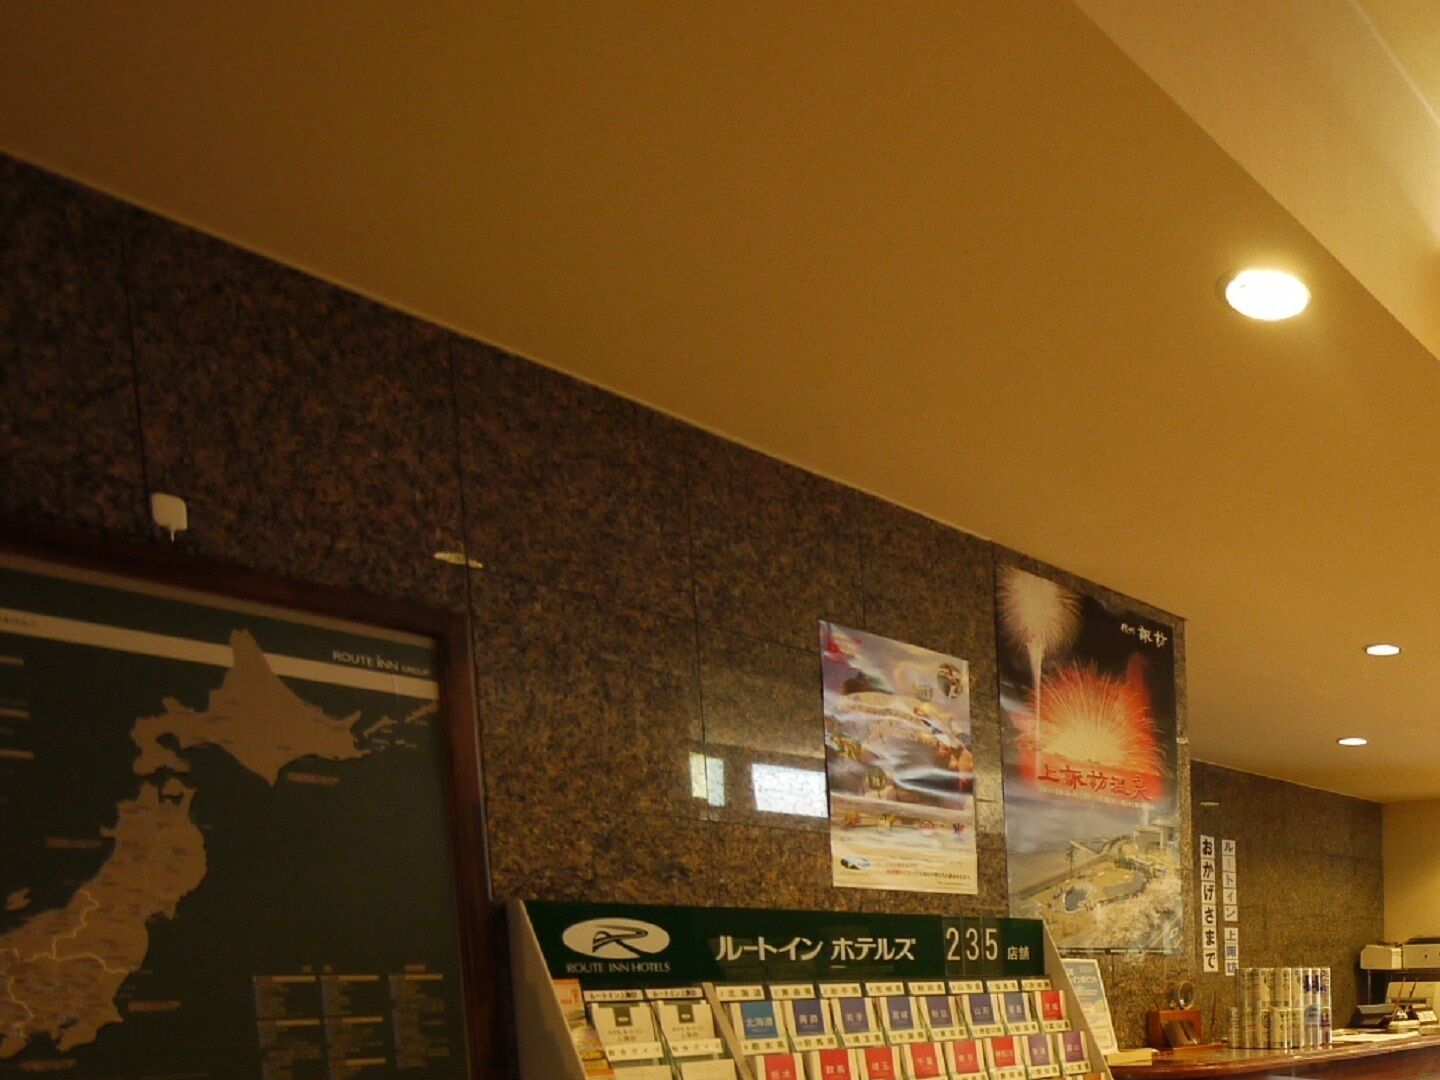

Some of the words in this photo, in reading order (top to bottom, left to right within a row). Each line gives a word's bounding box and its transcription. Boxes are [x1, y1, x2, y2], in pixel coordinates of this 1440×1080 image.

[332, 649, 374, 668] ROUTE
[1202, 838, 1216, 969] おかげさまで
[715, 935, 824, 961] ルートイン
[830, 937, 916, 961] ホテルズ
[946, 927, 998, 961] 235
[1007, 945, 1030, 961] 店舗
[566, 962, 604, 974] ROUTE
[608, 962, 631, 973] INN
[632, 961, 671, 973] HOTELS
